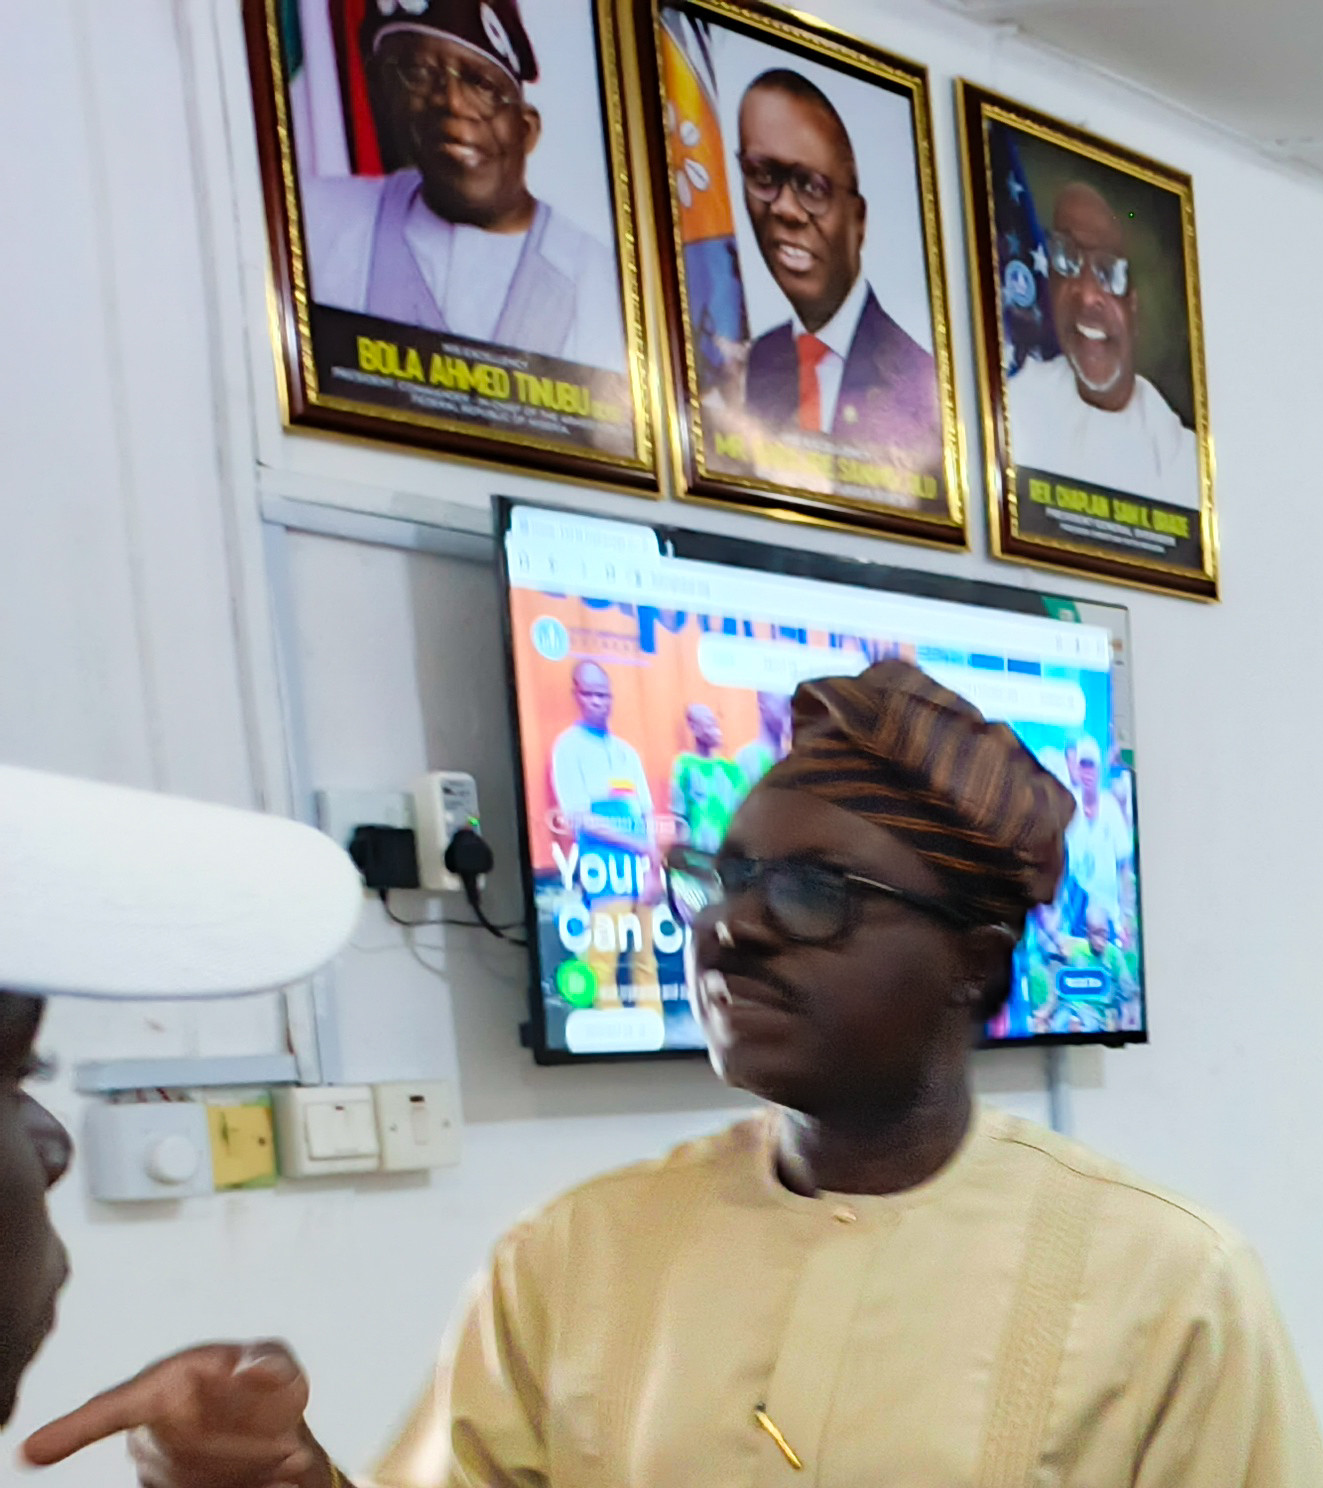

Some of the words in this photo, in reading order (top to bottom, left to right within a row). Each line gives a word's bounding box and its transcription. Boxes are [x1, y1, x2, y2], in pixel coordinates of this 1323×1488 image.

[357, 336, 424, 382] BOLA
[430, 354, 510, 400] AHMED
[552, 842, 650, 894] Your
[559, 902, 642, 957] Can
